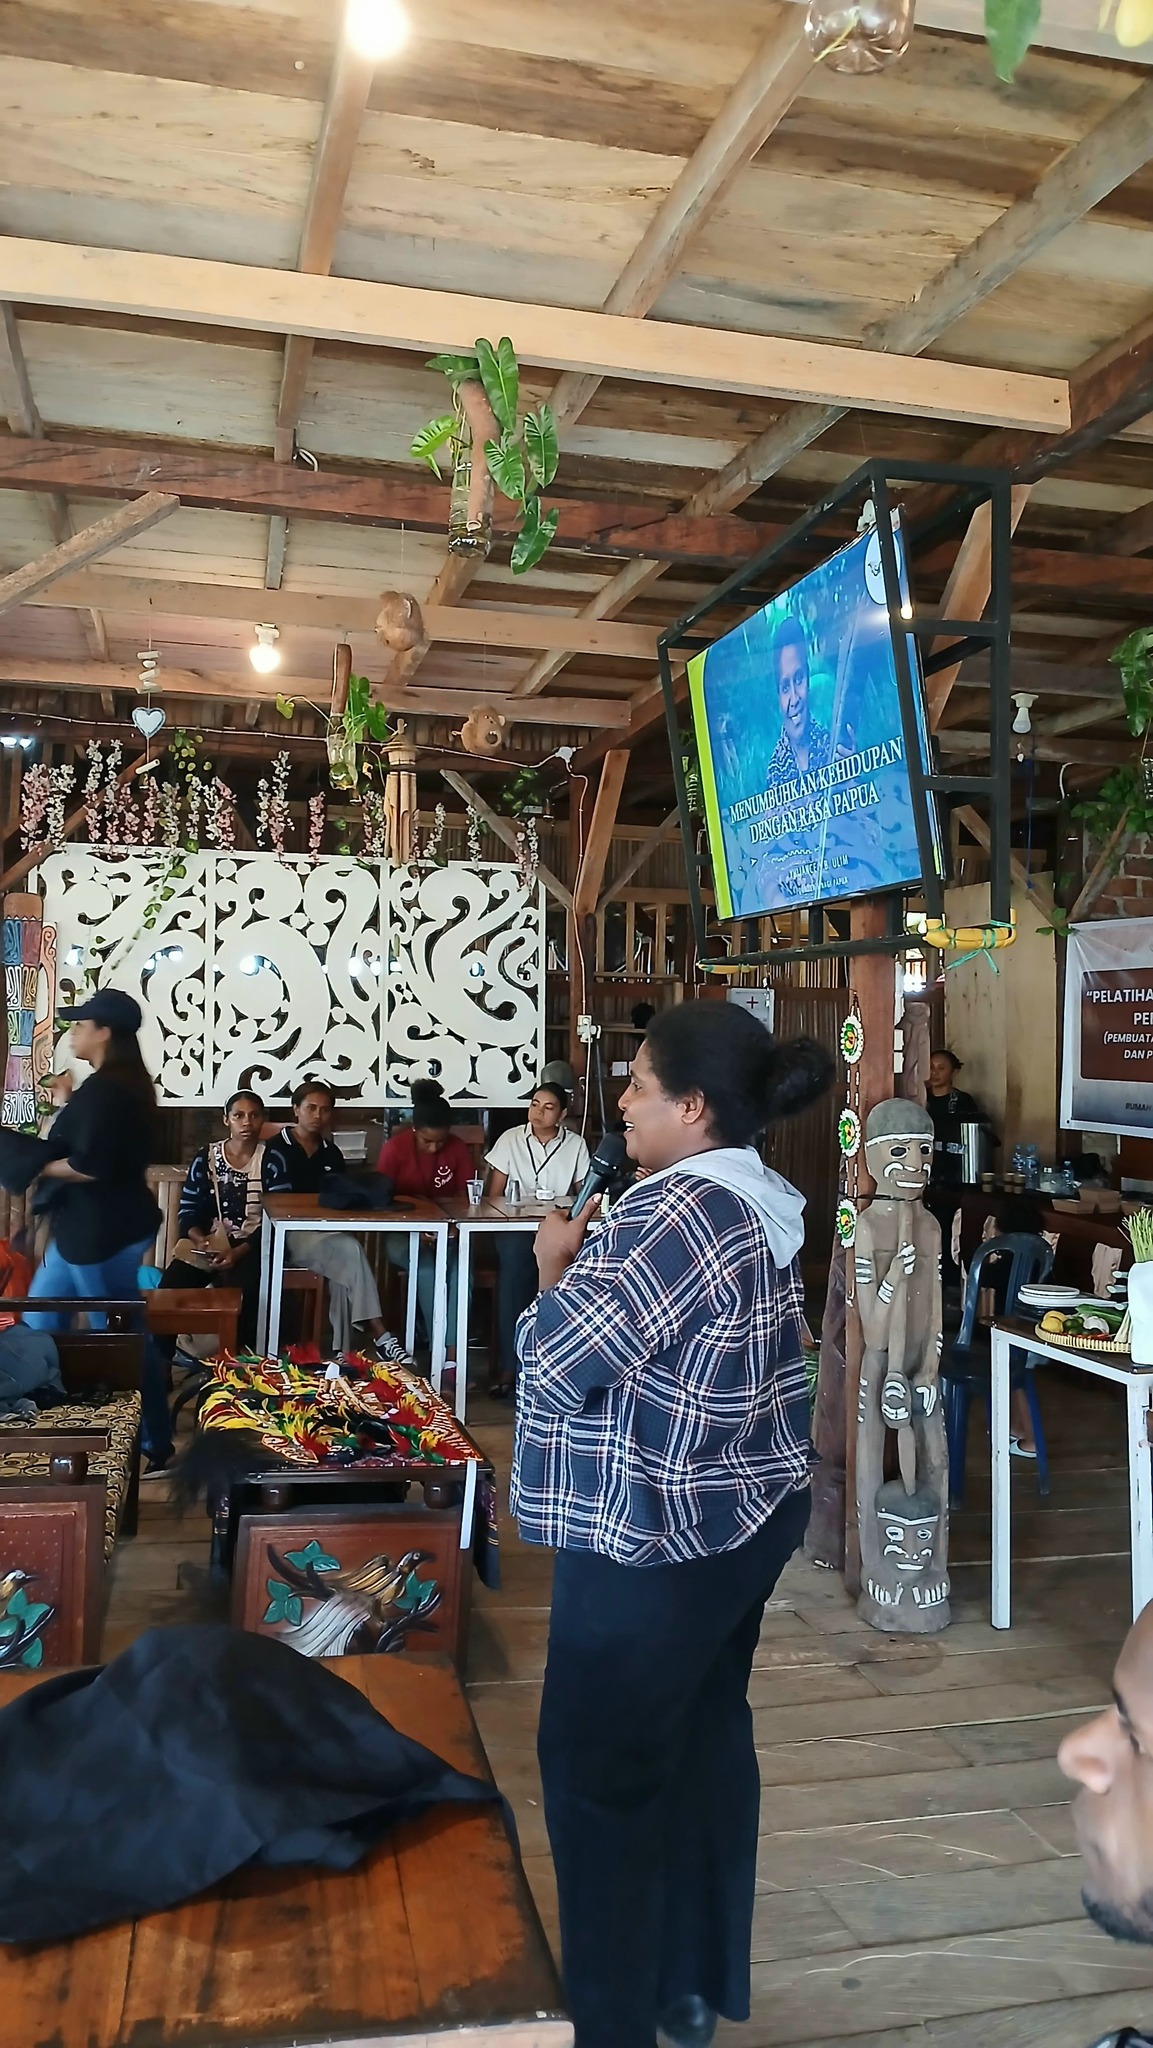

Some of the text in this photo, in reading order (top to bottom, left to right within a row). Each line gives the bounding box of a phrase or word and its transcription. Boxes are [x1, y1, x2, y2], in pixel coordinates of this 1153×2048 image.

[729, 736, 903, 823] MENUMBUHKAN KEHIDUPAN
[749, 781, 880, 844] DENGAN RASA PAPUA
[1123, 1049, 1145, 1059] DAN
[1125, 1102, 1151, 1111] RUMAH
